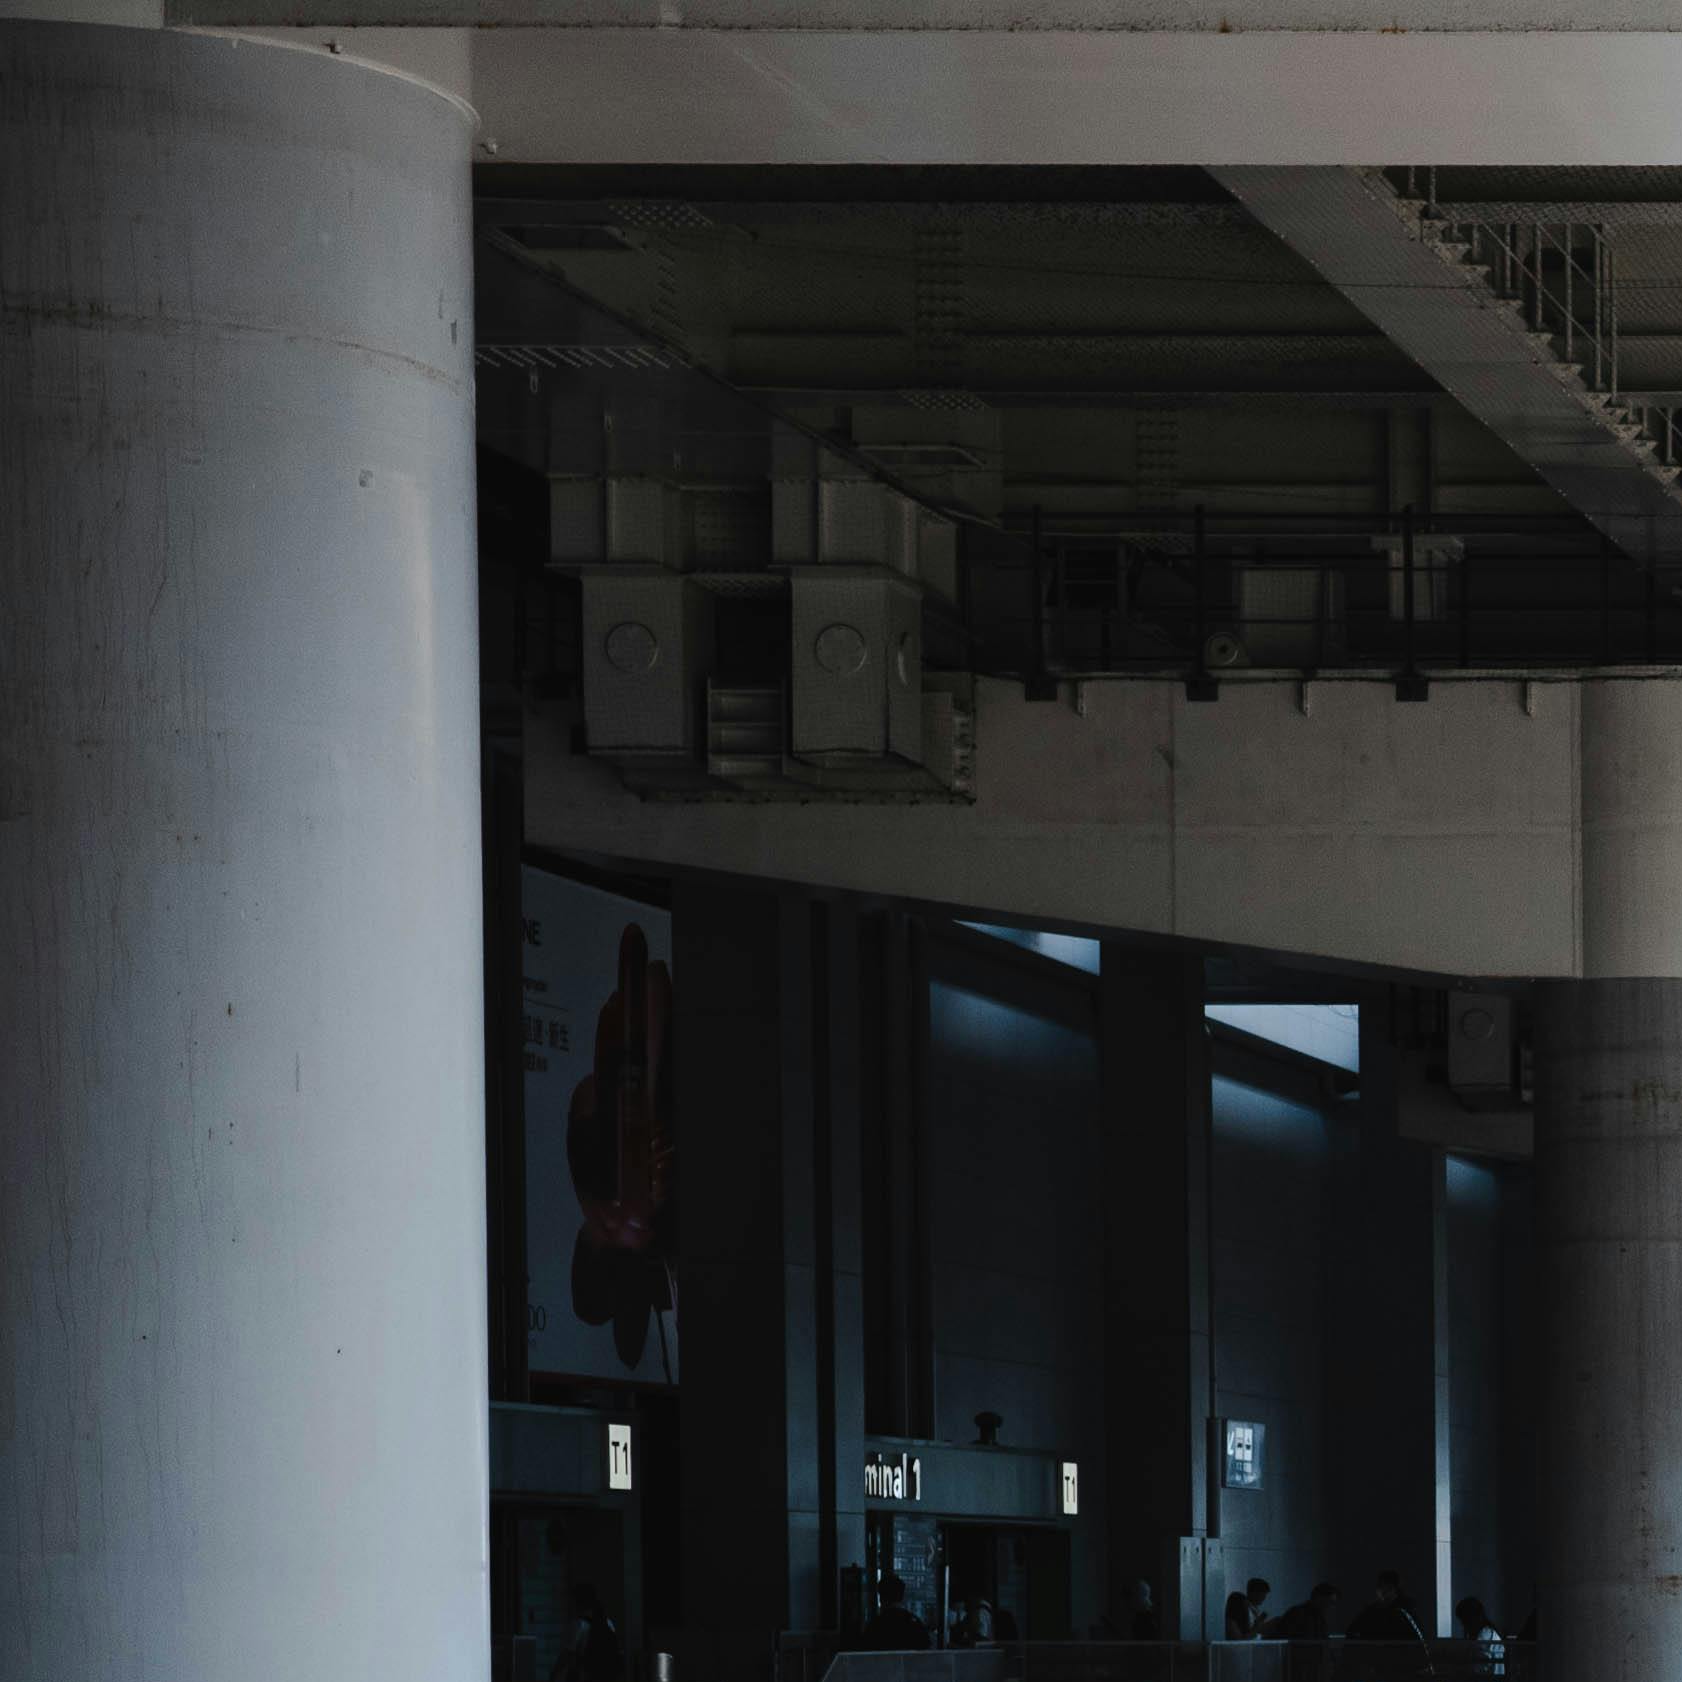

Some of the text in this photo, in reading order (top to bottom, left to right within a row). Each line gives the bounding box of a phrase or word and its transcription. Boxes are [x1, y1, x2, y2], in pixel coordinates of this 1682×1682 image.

[610, 1440, 630, 1478] T1
[864, 1452, 921, 1501] minal 1
